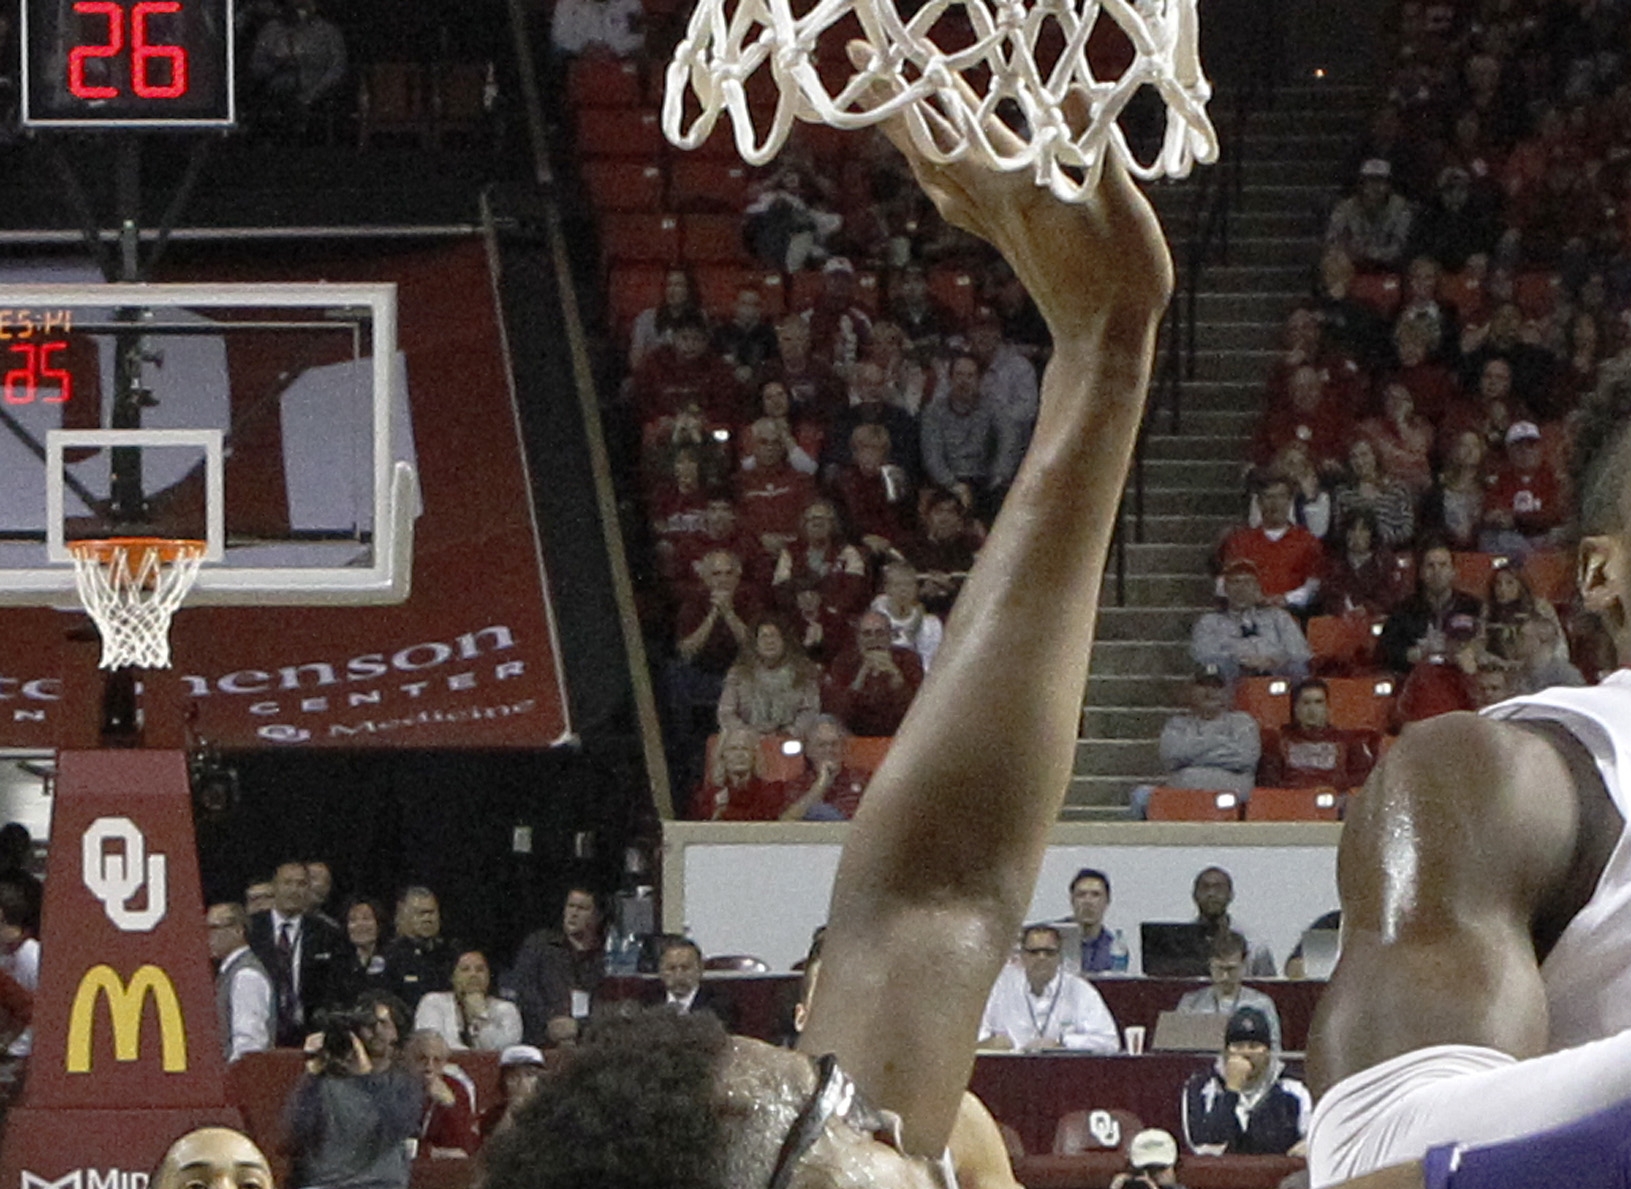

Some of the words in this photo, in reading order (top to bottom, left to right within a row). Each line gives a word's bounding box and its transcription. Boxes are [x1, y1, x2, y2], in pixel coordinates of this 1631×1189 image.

[67, 1, 189, 99] 26
[250, 660, 525, 715] CENTER
[82, 817, 166, 931] OU
[1089, 1109, 1120, 1146] OU
